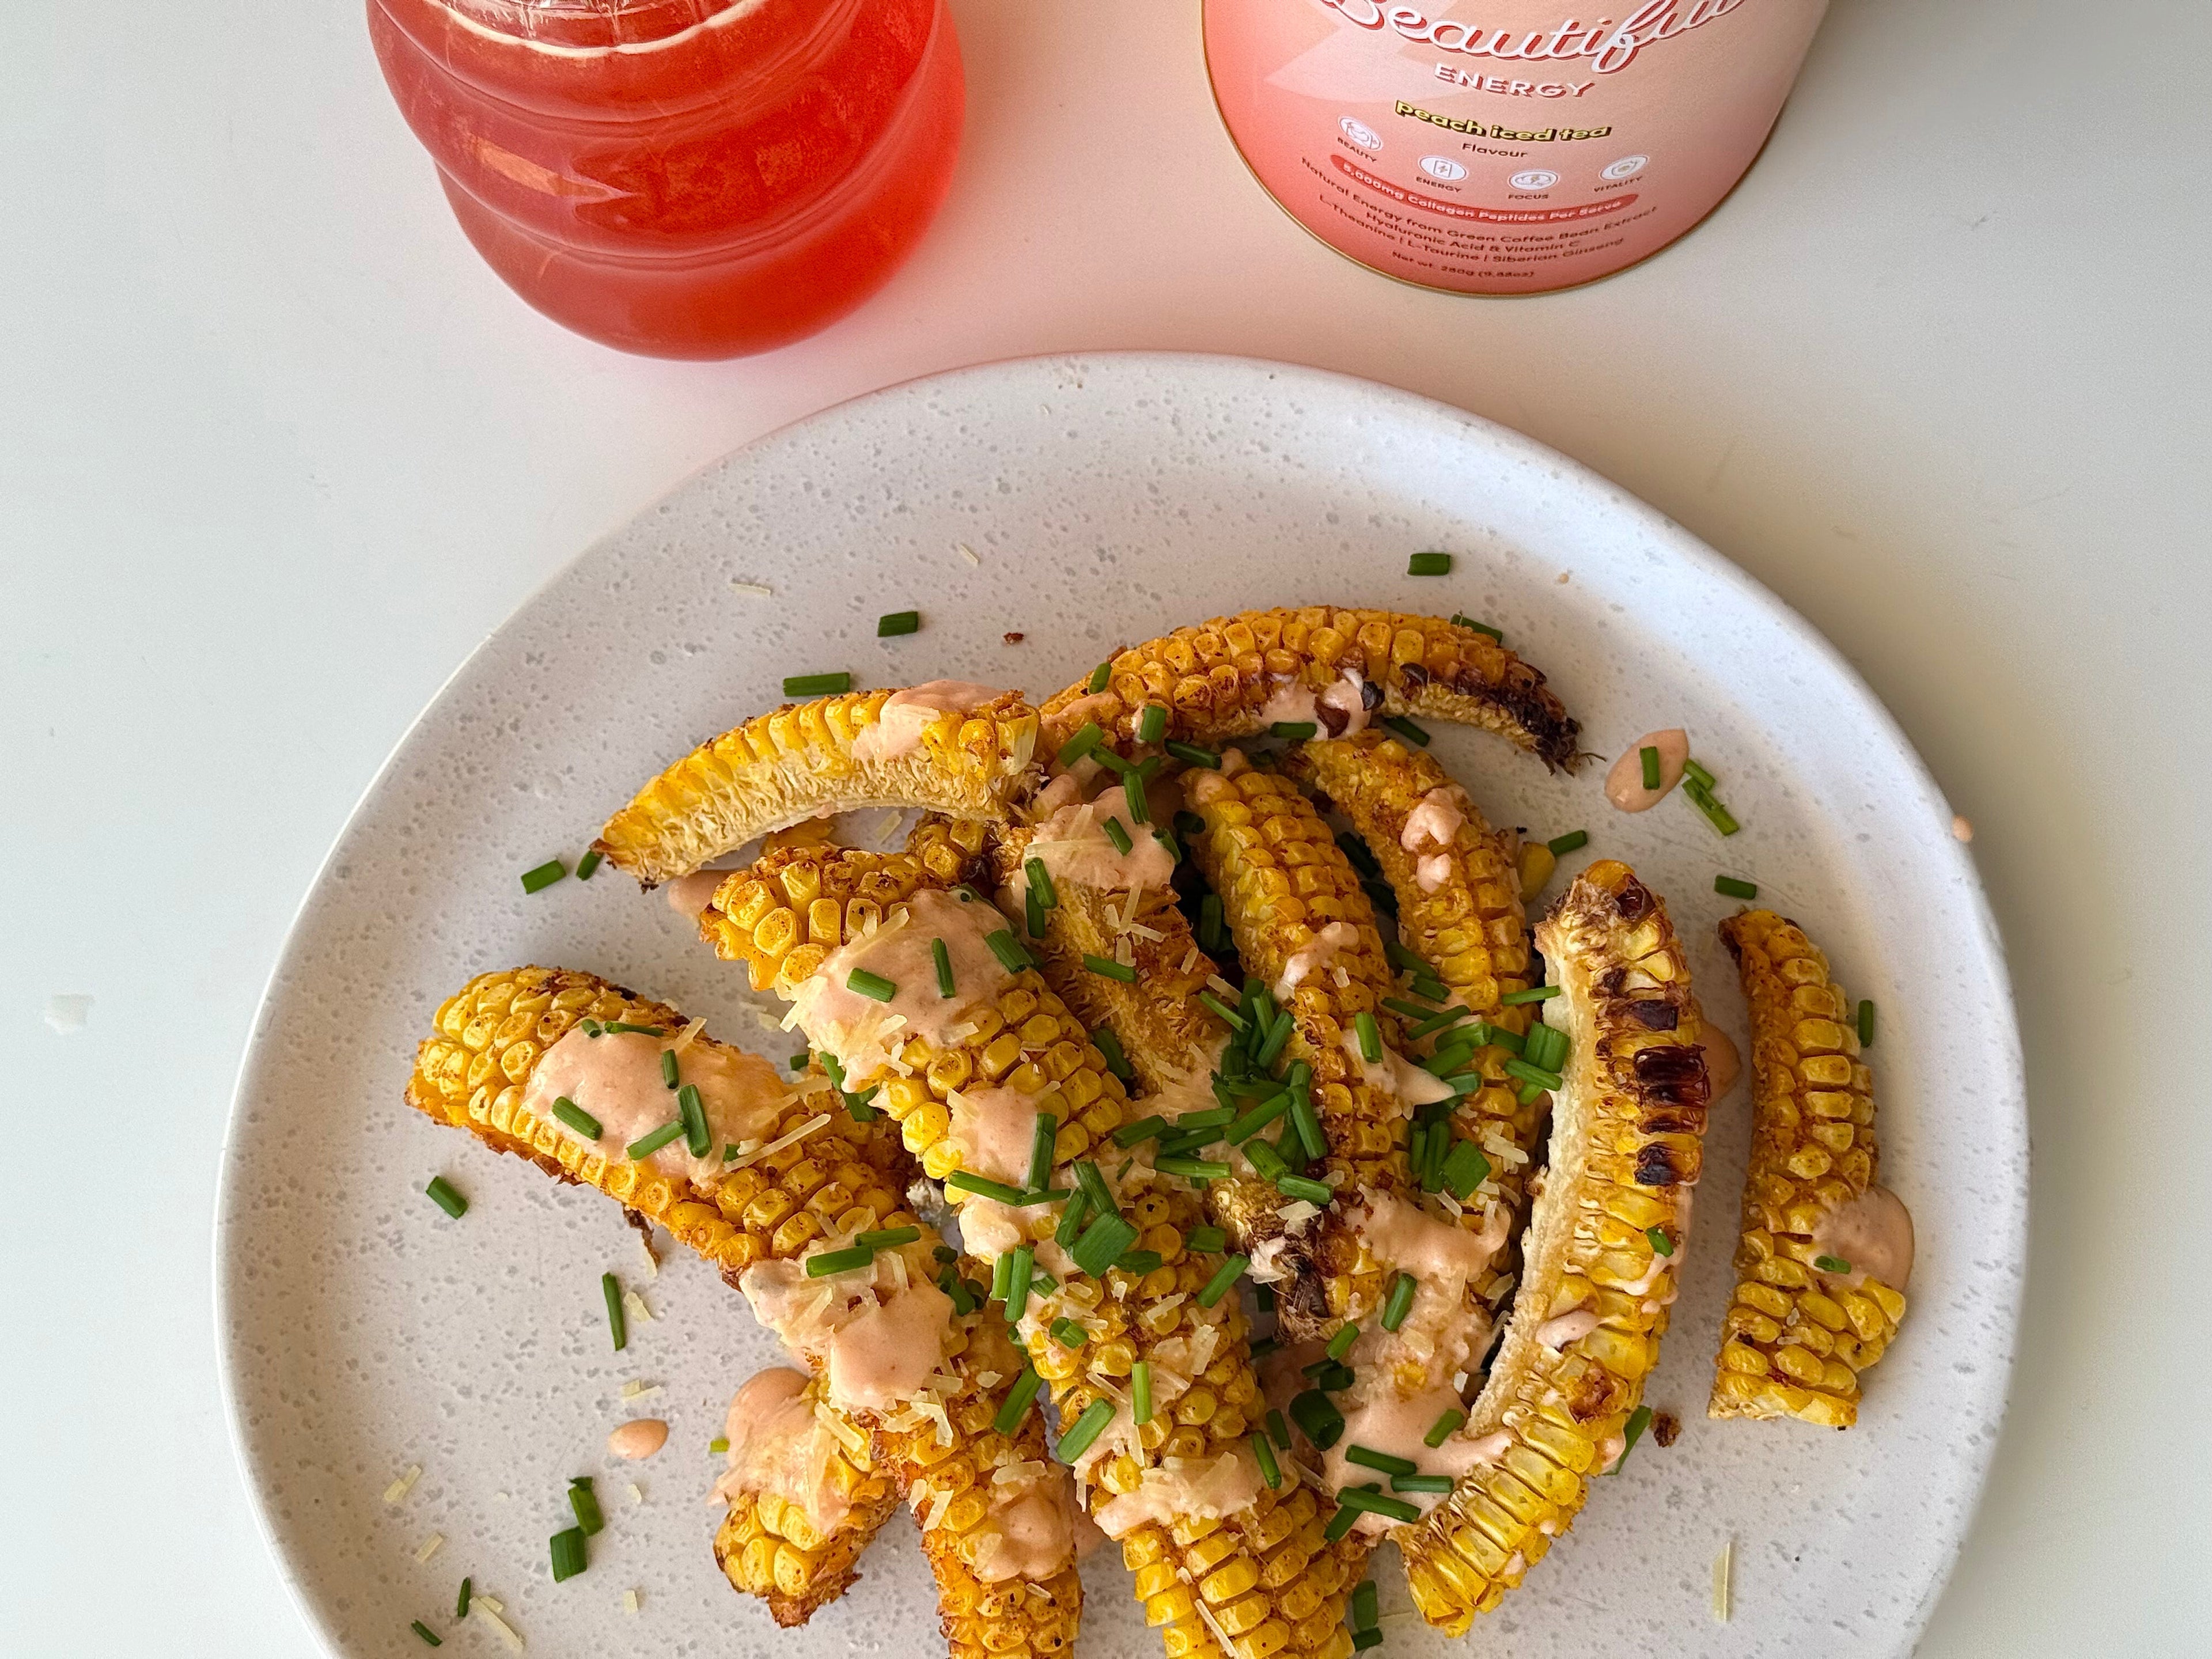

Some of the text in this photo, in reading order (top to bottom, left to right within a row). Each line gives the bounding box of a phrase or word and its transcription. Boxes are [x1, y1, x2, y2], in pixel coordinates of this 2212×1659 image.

[1319, 0, 1745, 74] eautifu
[1434, 63, 1596, 98] ENERGY
[1395, 100, 1612, 142] peach iced tea
[1338, 137, 1377, 162] BEAUTY
[1462, 143, 1528, 158] Flavour
[1416, 176, 1461, 193] ENERGY
[1593, 176, 1643, 192] VITALITY
[1301, 157, 1657, 243] Natural Energy from Green Coffee Bean Extract
[1407, 194, 1475, 217] Collagen
[1478, 211, 1545, 222] Peptides
[1550, 211, 1576, 219] Per
[1580, 200, 1622, 215] Serve
[1319, 193, 1396, 241] L-Theanine
[1407, 240, 1480, 261] L-Taurine
[1493, 254, 1557, 263] Siberian
[1562, 237, 1624, 257] Ginseng
[1366, 211, 1445, 245] Hyaluronic
[1450, 241, 1484, 252] Acid
[1505, 243, 1563, 253] Vitamin
[1392, 251, 1414, 262] Net
